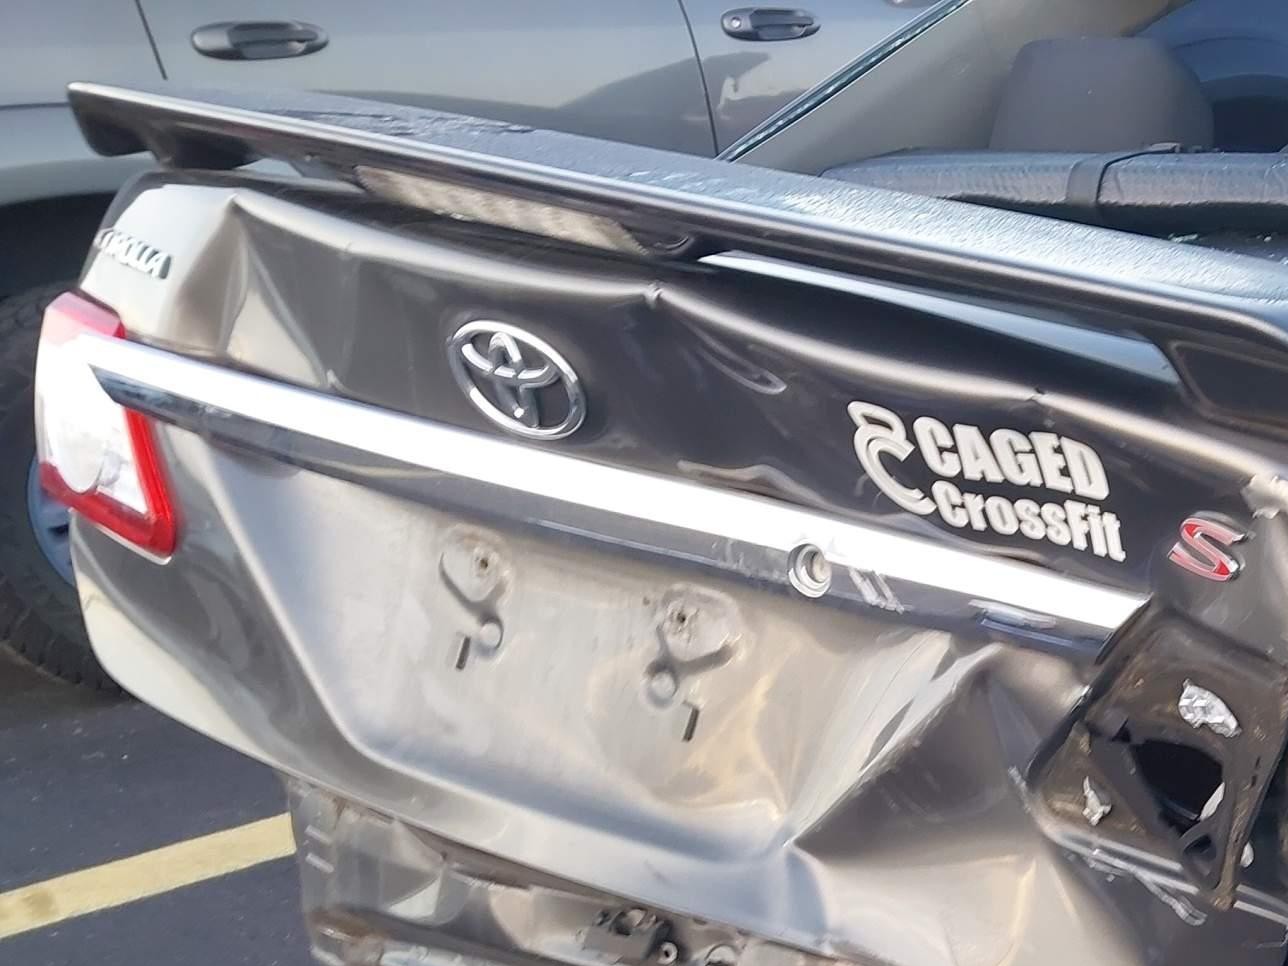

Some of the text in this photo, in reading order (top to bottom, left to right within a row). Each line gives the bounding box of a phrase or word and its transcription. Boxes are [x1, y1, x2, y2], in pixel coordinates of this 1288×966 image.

[913, 416, 1110, 500] CAGED
[931, 481, 1126, 562] CrossFit
[1167, 514, 1248, 582] S
